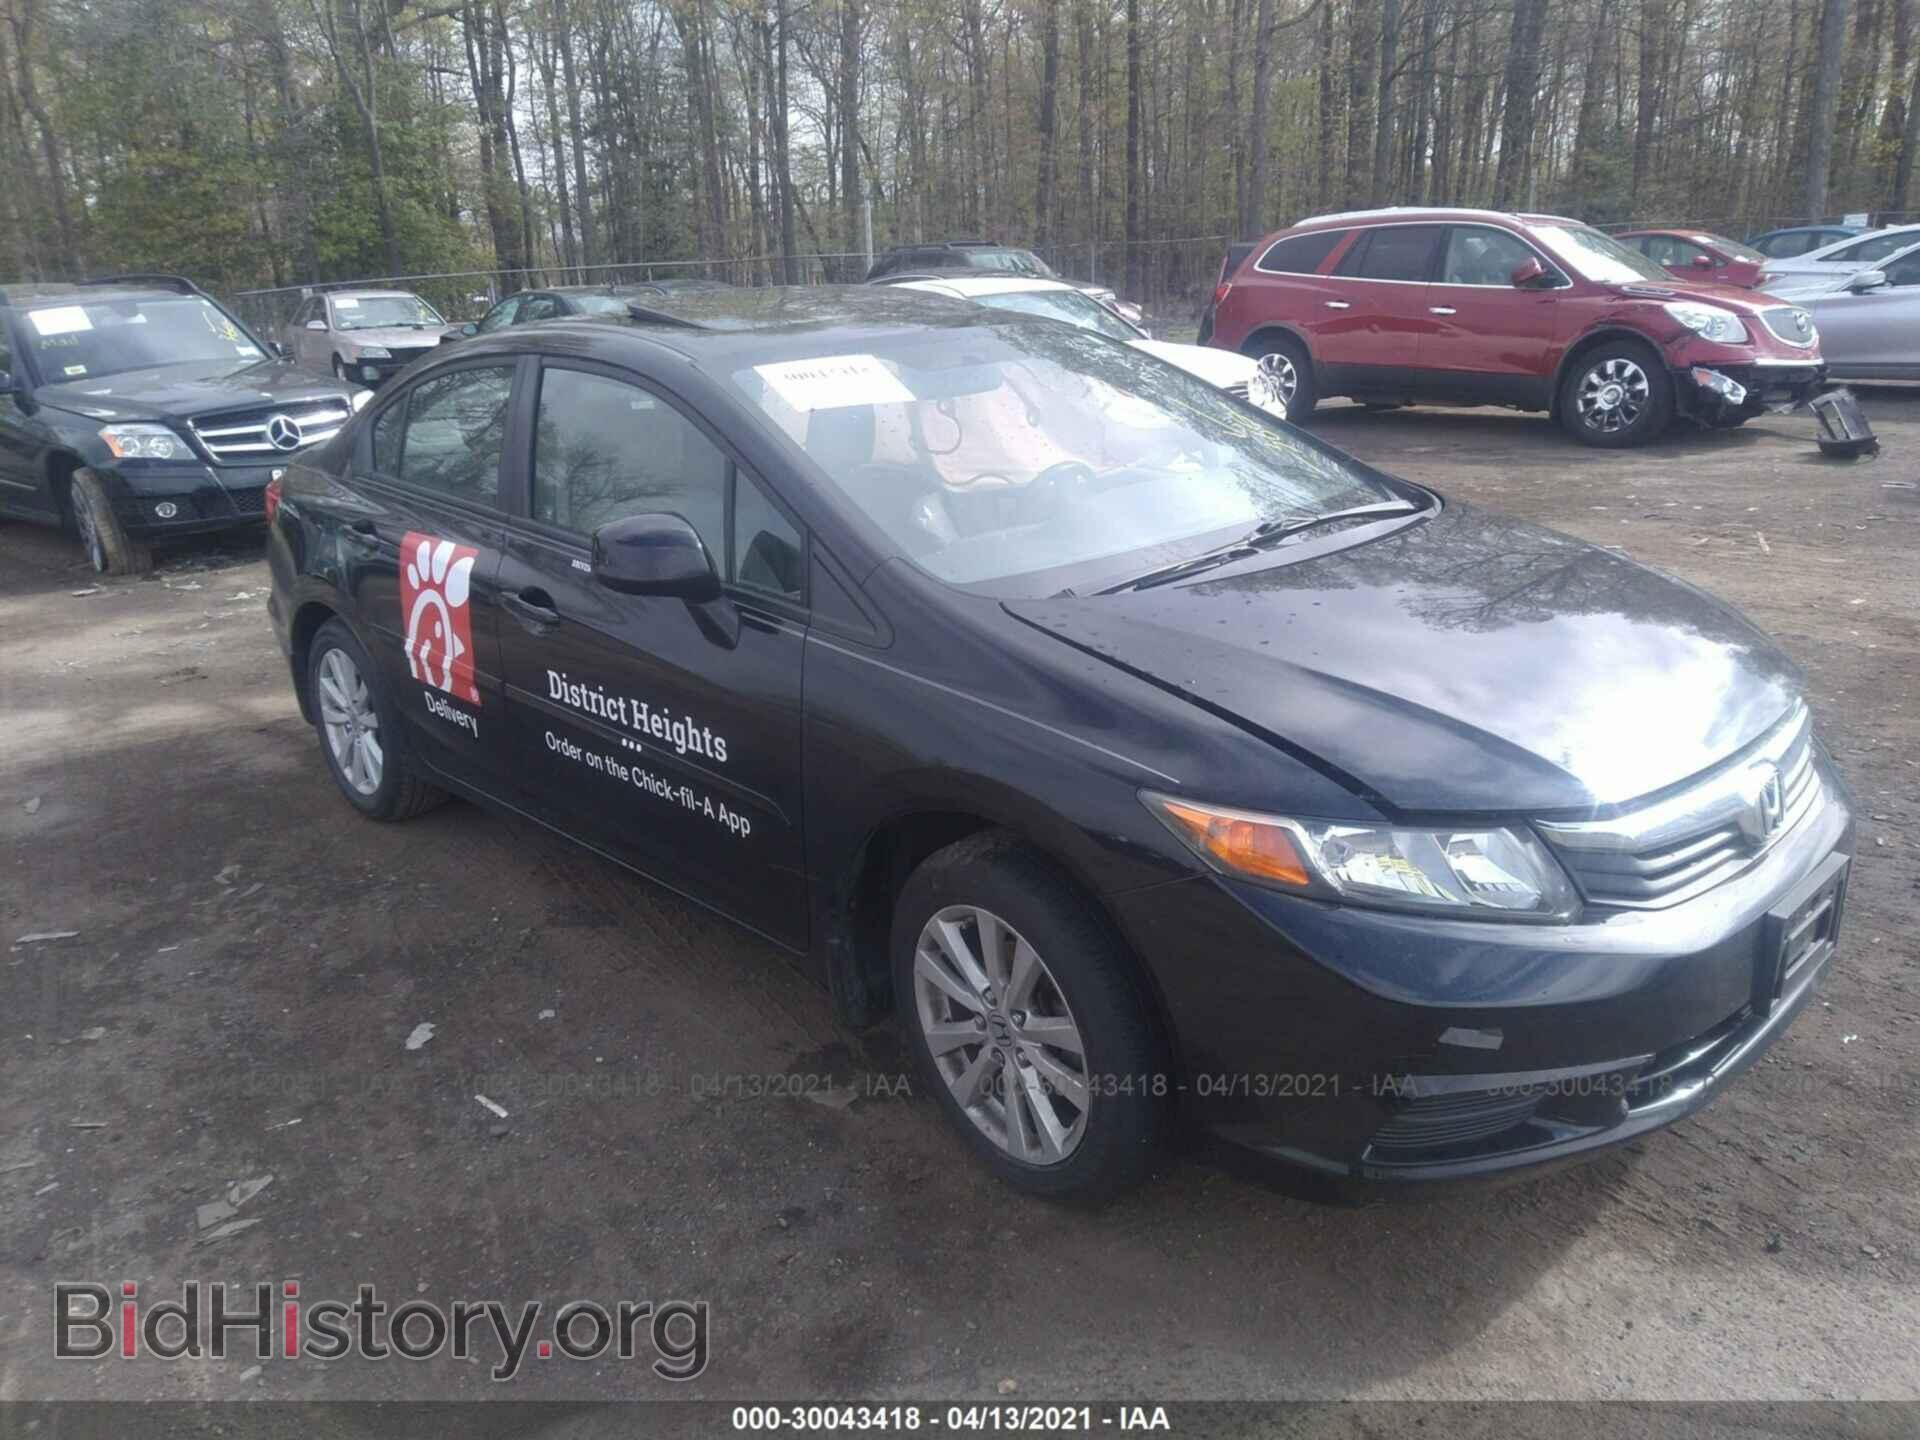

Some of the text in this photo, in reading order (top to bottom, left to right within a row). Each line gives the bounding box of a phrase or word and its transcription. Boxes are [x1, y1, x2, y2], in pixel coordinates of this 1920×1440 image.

[424, 691, 479, 739] Delivery
[546, 669, 728, 763] District Heights
[545, 731, 751, 838] Order on the Chick-fil-A App
